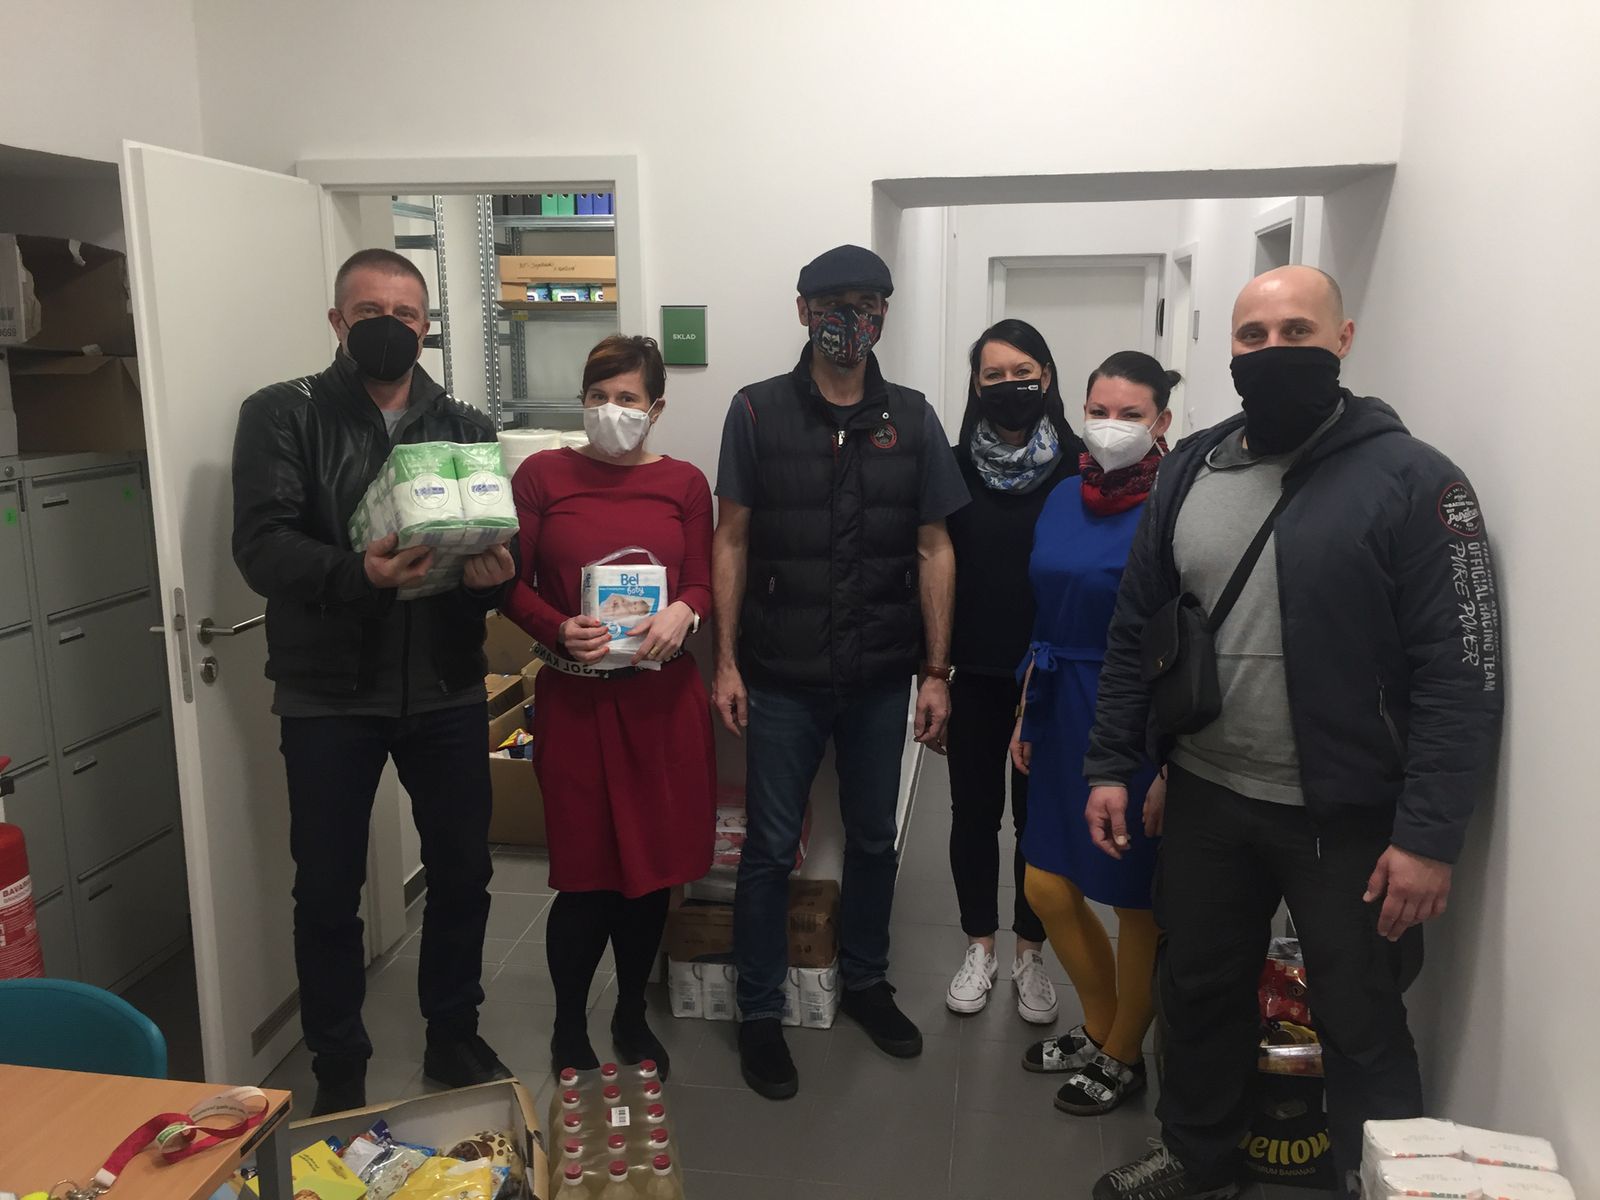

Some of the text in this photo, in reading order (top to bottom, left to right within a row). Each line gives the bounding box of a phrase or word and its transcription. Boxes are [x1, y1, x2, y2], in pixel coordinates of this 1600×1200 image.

[620, 573, 639, 586] Bel
[1448, 541, 1470, 599] PURE
[1458, 600, 1480, 667] POWER
[1467, 542, 1489, 601] OFFICIAL
[1483, 654, 1496, 692] TEAM
